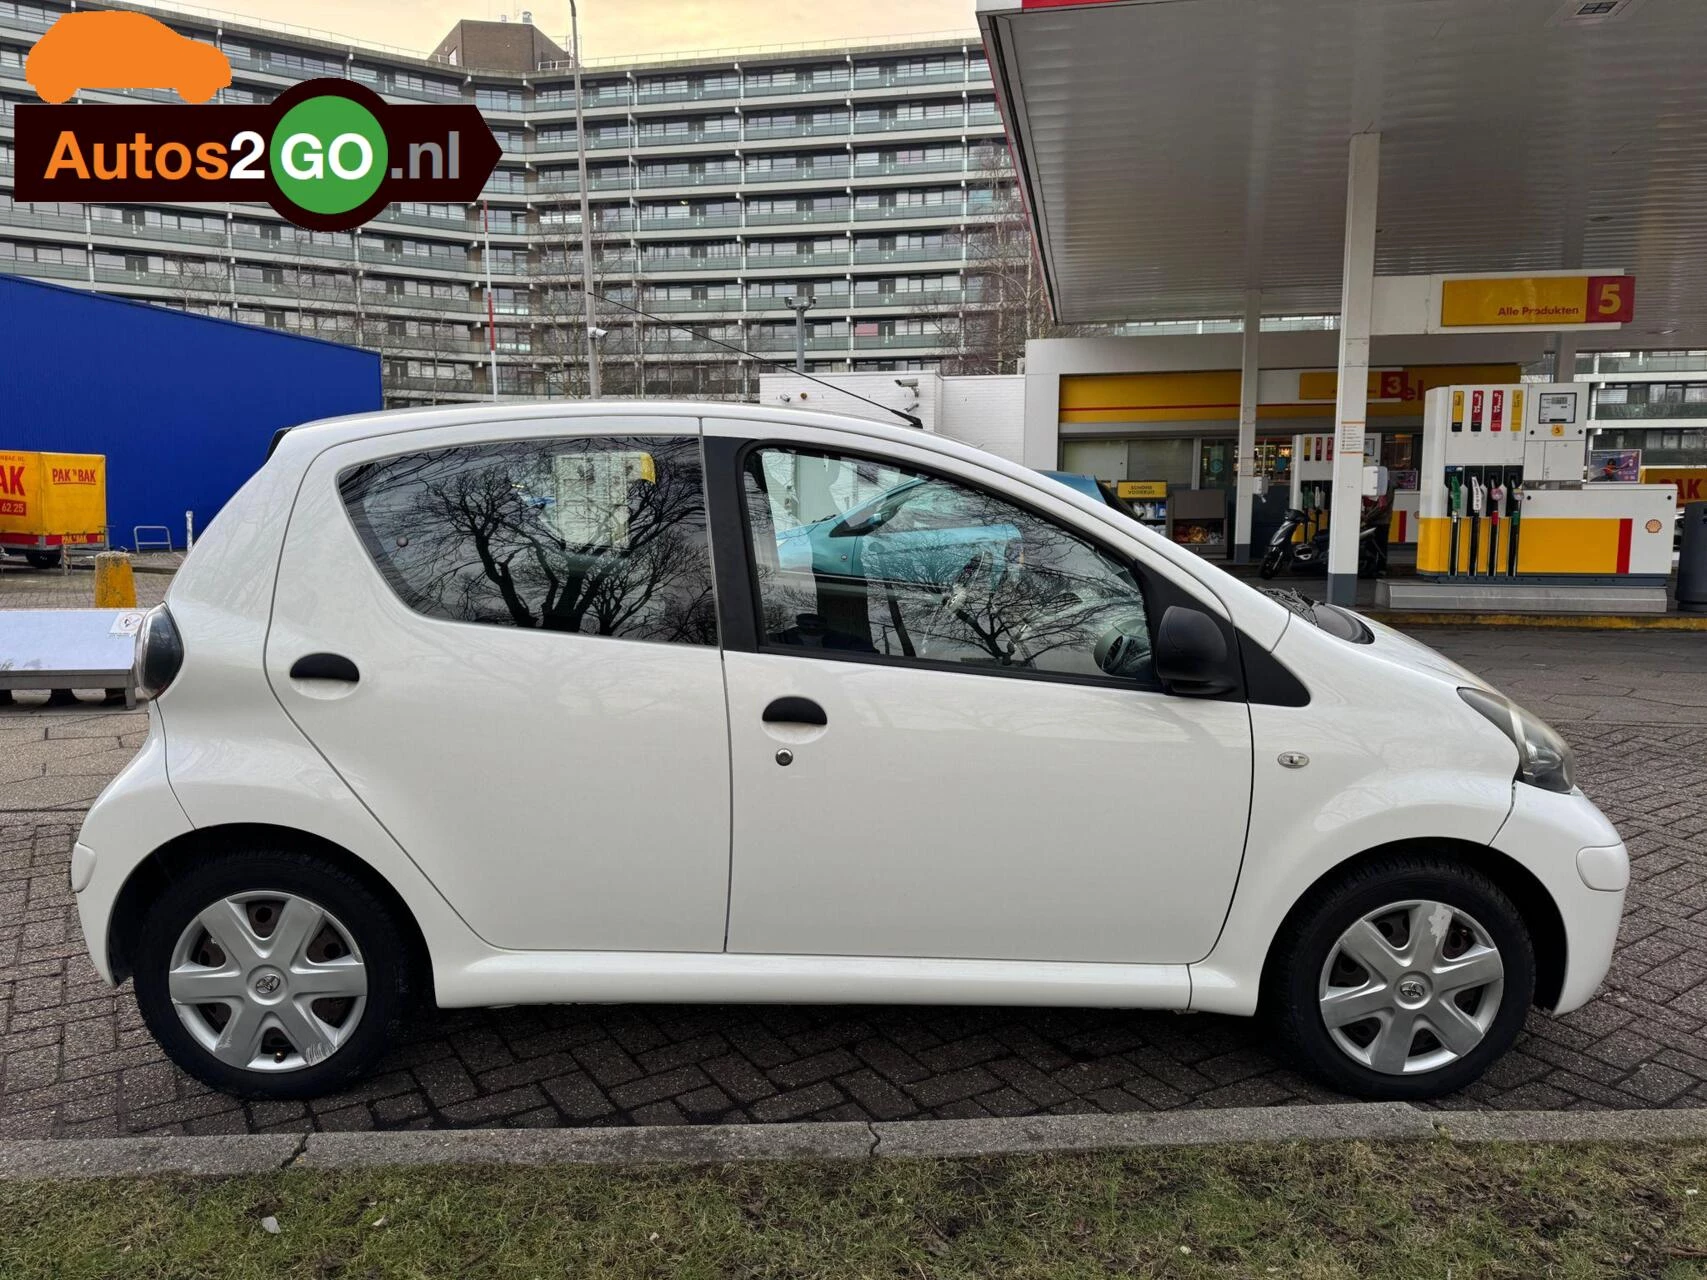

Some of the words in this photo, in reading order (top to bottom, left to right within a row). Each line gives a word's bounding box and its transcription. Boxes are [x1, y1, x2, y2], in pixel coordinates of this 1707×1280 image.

[1598, 283, 1621, 314] 5
[1498, 306, 1519, 316] Alle
[1522, 305, 1579, 315] Produkten
[1387, 376, 1402, 395] 3
[52, 468, 71, 482] PAK
[78, 469, 96, 483] BAK
[2, 503, 12, 512] 62
[13, 504, 24, 513] 25
